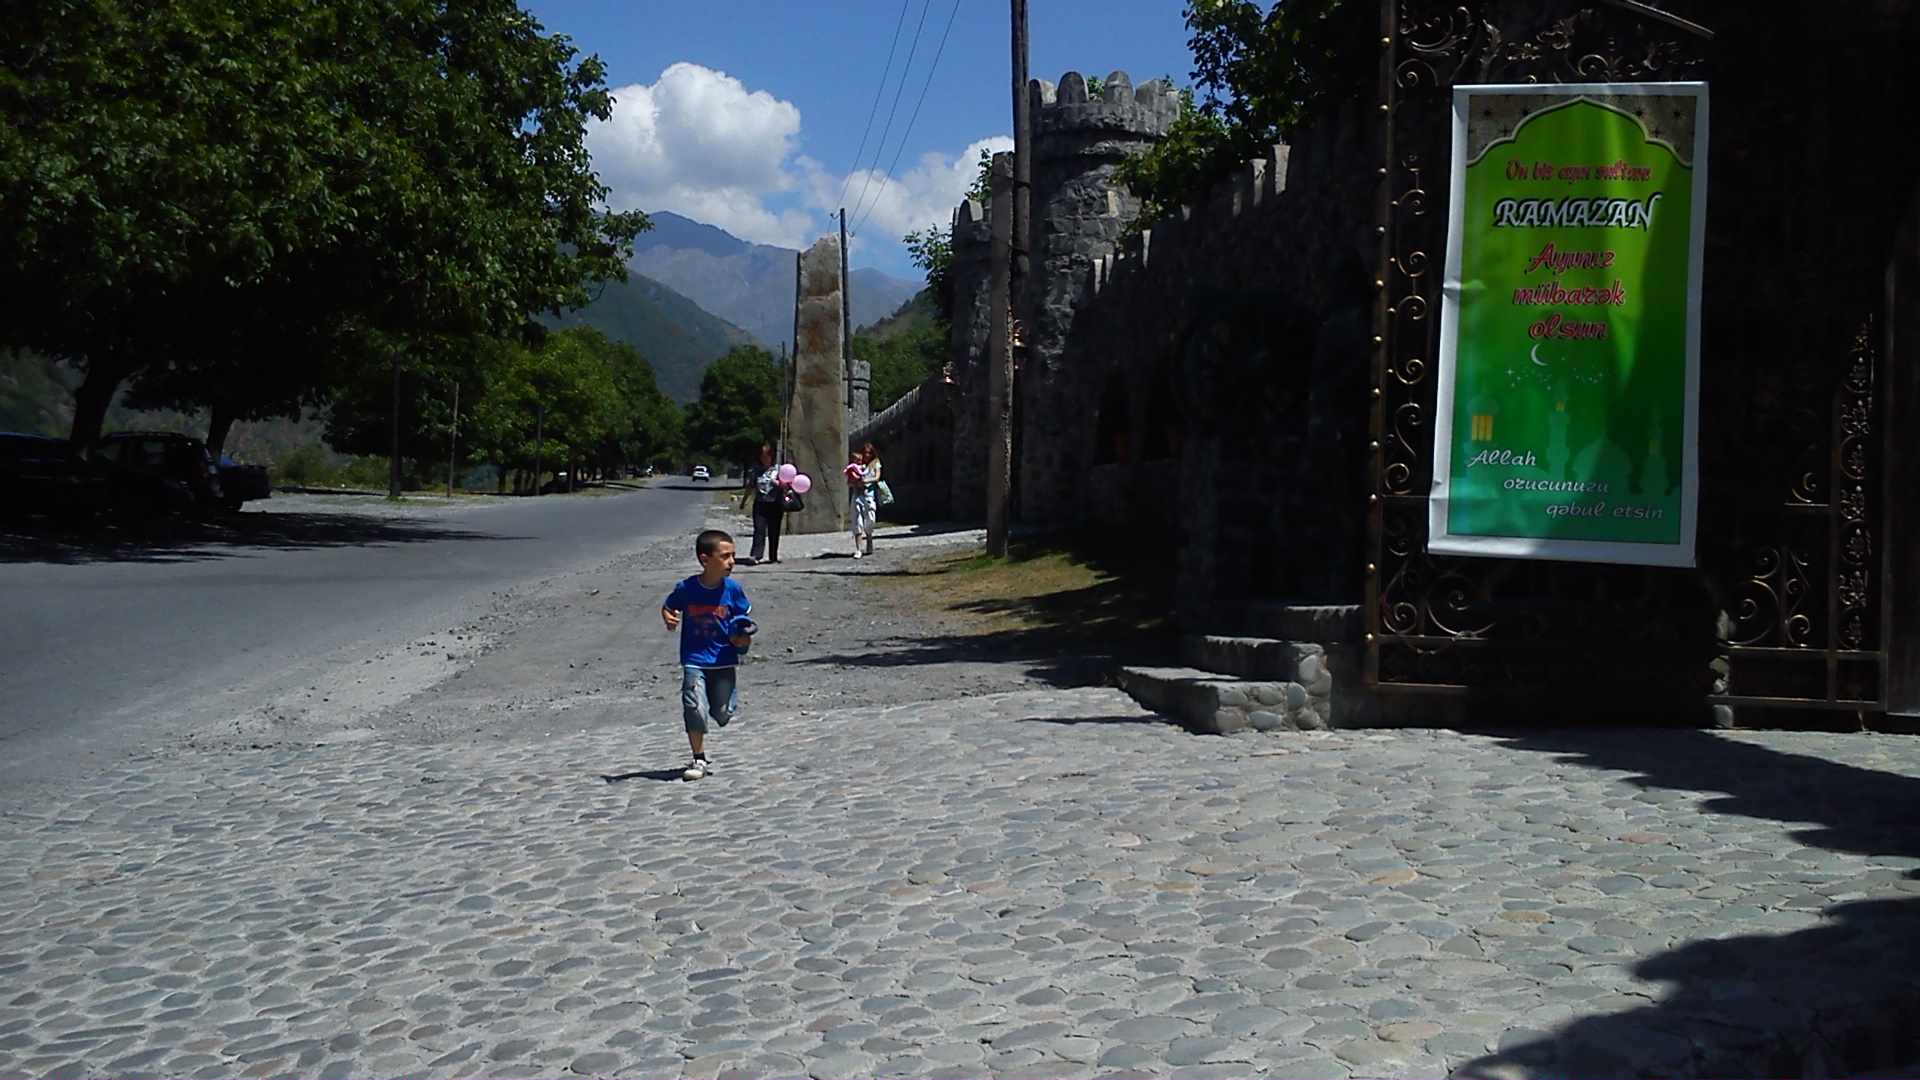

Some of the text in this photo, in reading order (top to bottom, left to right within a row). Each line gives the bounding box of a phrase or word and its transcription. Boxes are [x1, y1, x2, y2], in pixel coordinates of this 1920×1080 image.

[1506, 158, 1528, 180] On
[1533, 161, 1555, 180] bir
[1493, 192, 1663, 231] RAMAZAN
[1526, 242, 1616, 274] Ayınız
[1514, 280, 1625, 305] mübarək
[1529, 312, 1608, 339] olsun
[1467, 450, 1537, 467] Allah
[1503, 478, 1609, 493] orucunuzu
[1546, 502, 1663, 519] qəbul etsin
